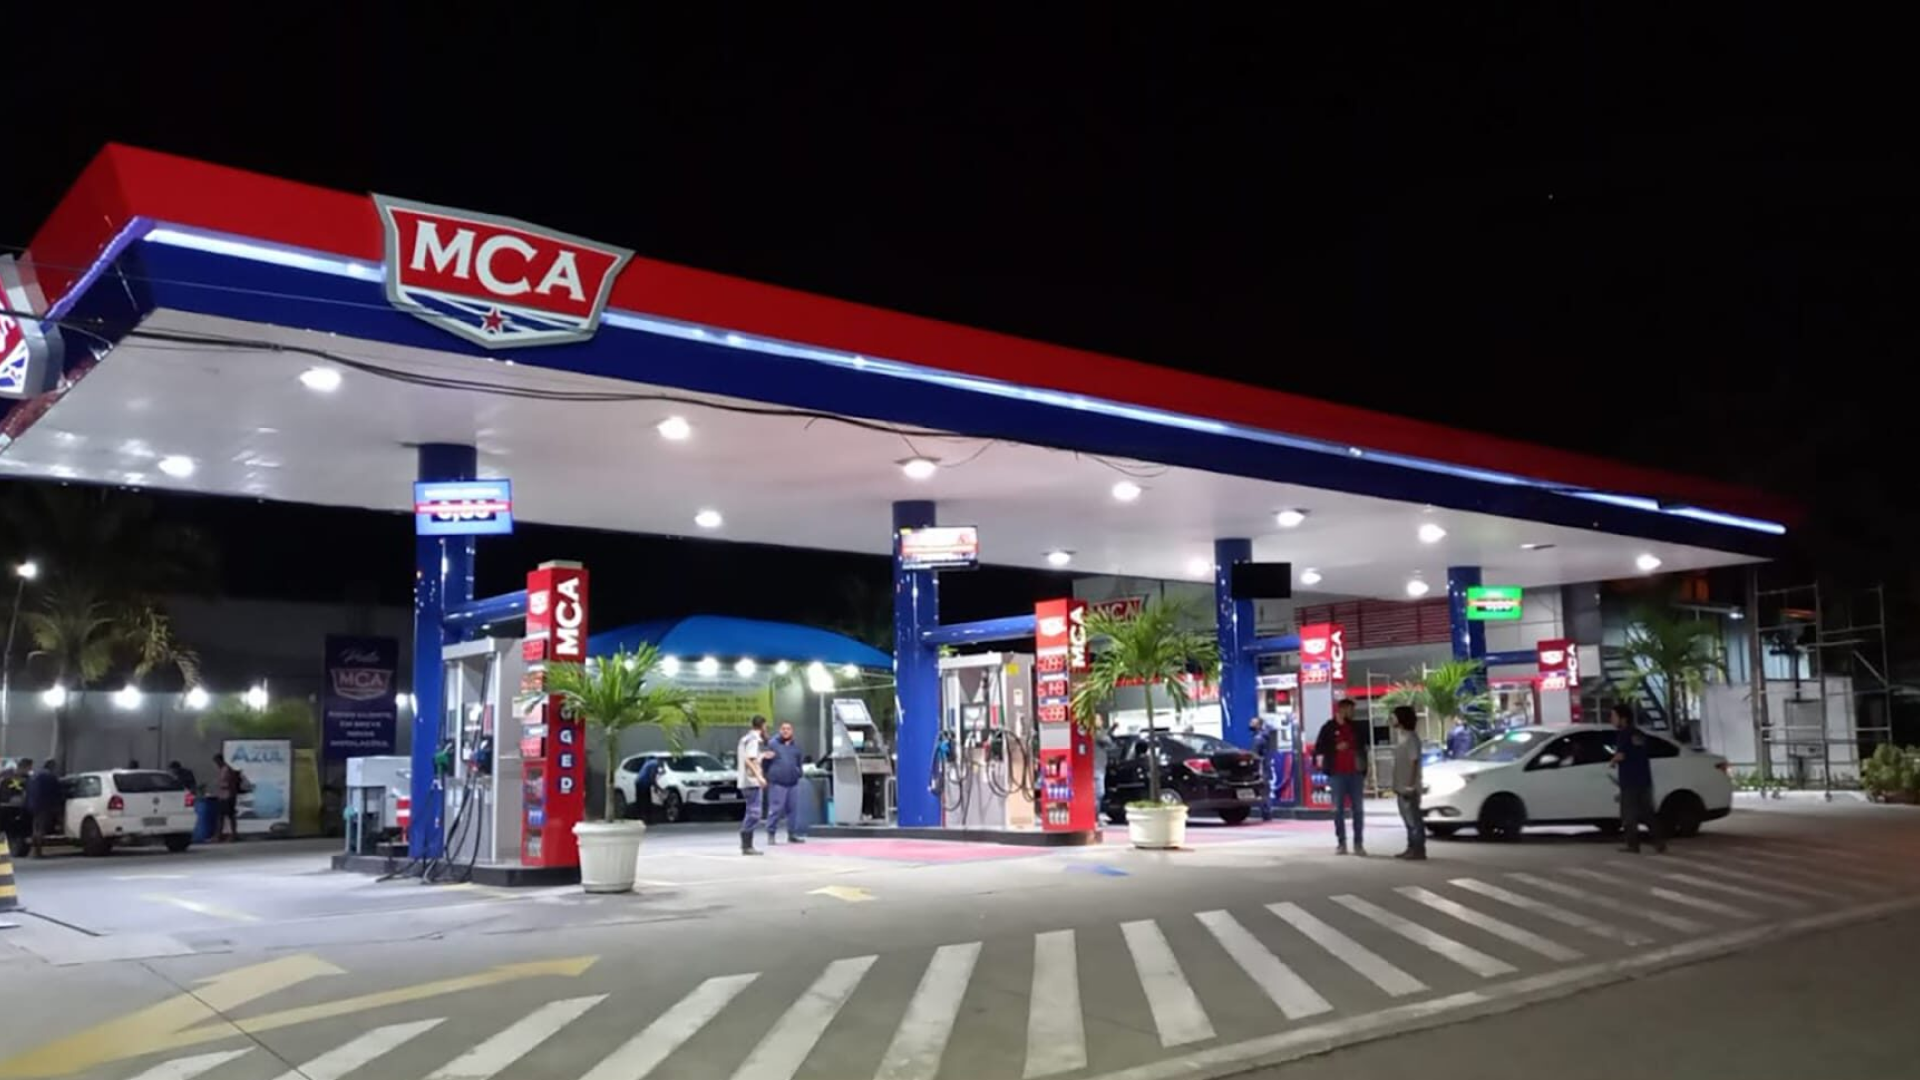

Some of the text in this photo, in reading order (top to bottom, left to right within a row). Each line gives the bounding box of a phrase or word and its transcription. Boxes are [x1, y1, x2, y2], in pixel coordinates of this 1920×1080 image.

[409, 219, 587, 302] MCA
[555, 577, 583, 656] MCA
[1070, 606, 1087, 668] MCA
[338, 671, 387, 688] MCA
[1331, 630, 1344, 679] MCA
[1567, 643, 1578, 686] MCA
